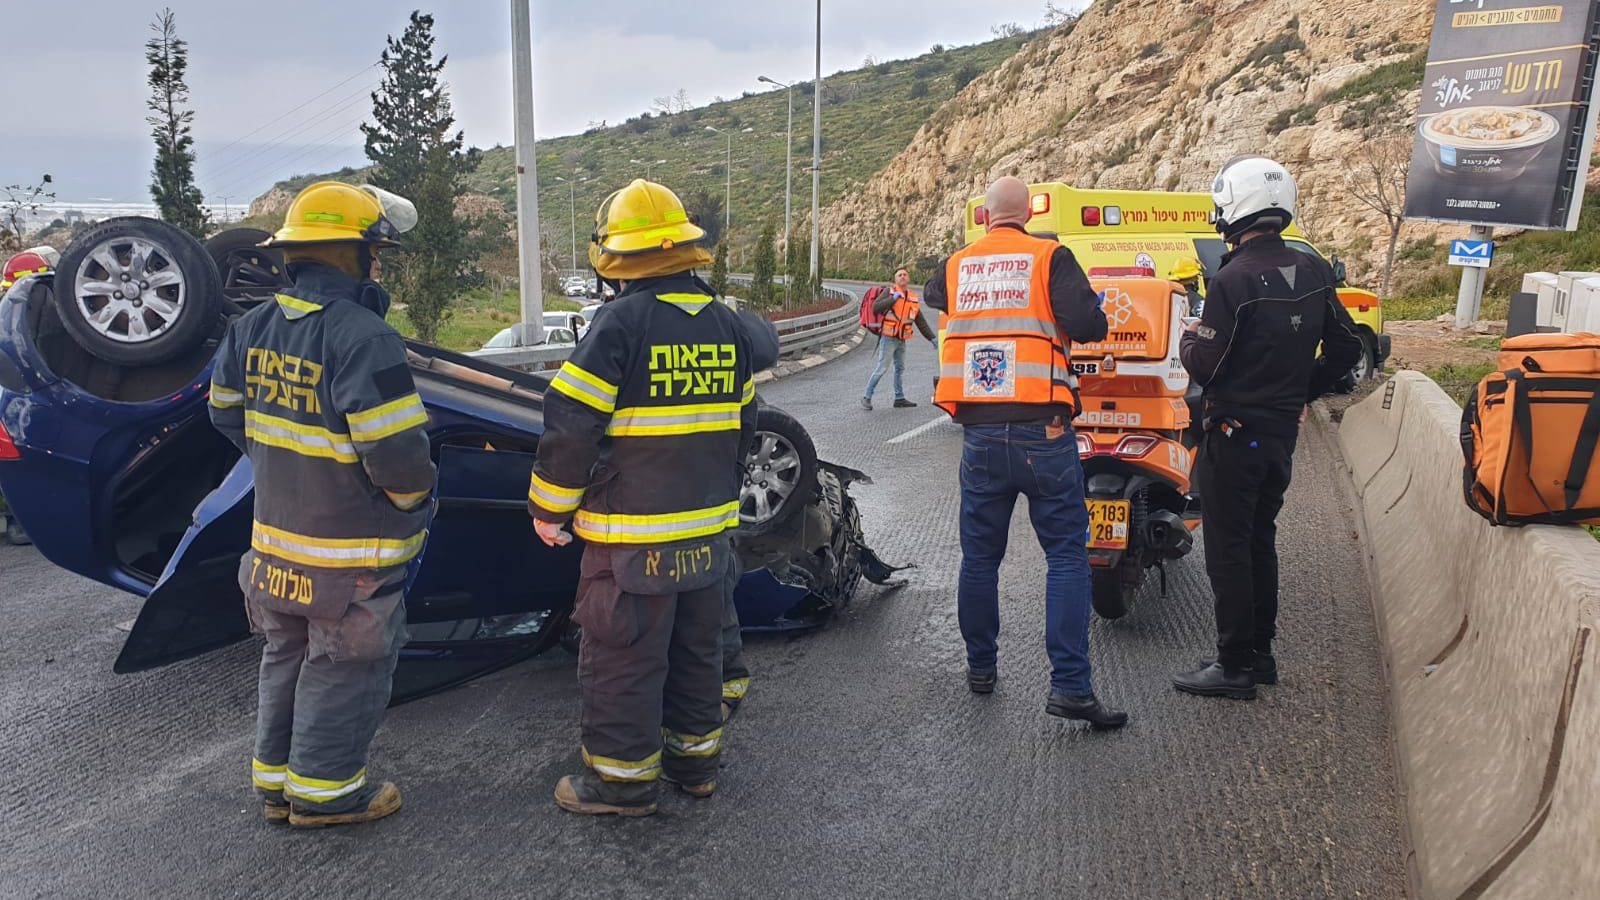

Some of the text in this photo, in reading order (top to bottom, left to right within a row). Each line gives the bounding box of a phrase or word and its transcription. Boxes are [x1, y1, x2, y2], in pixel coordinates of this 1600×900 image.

[1457, 14, 1479, 26] נהנים
[1487, 11, 1514, 25] מנגבים
[1502, 61, 1562, 94] חדש!
[1435, 78, 1474, 108] אחלה
[1122, 207, 1207, 225] ניידת טיפול נמרץ
[961, 260, 1029, 276] פרמדיק אזורי
[959, 289, 1025, 303] איחוד הצלה
[1110, 331, 1147, 341] איחוד
[649, 344, 736, 369] כבאות
[246, 347, 323, 385] כבאות
[1072, 363, 1097, 374] 98
[650, 370, 735, 397] והצלה
[245, 375, 321, 414] והצלה
[1095, 524, 1113, 541] 28
[645, 550, 660, 576] א
